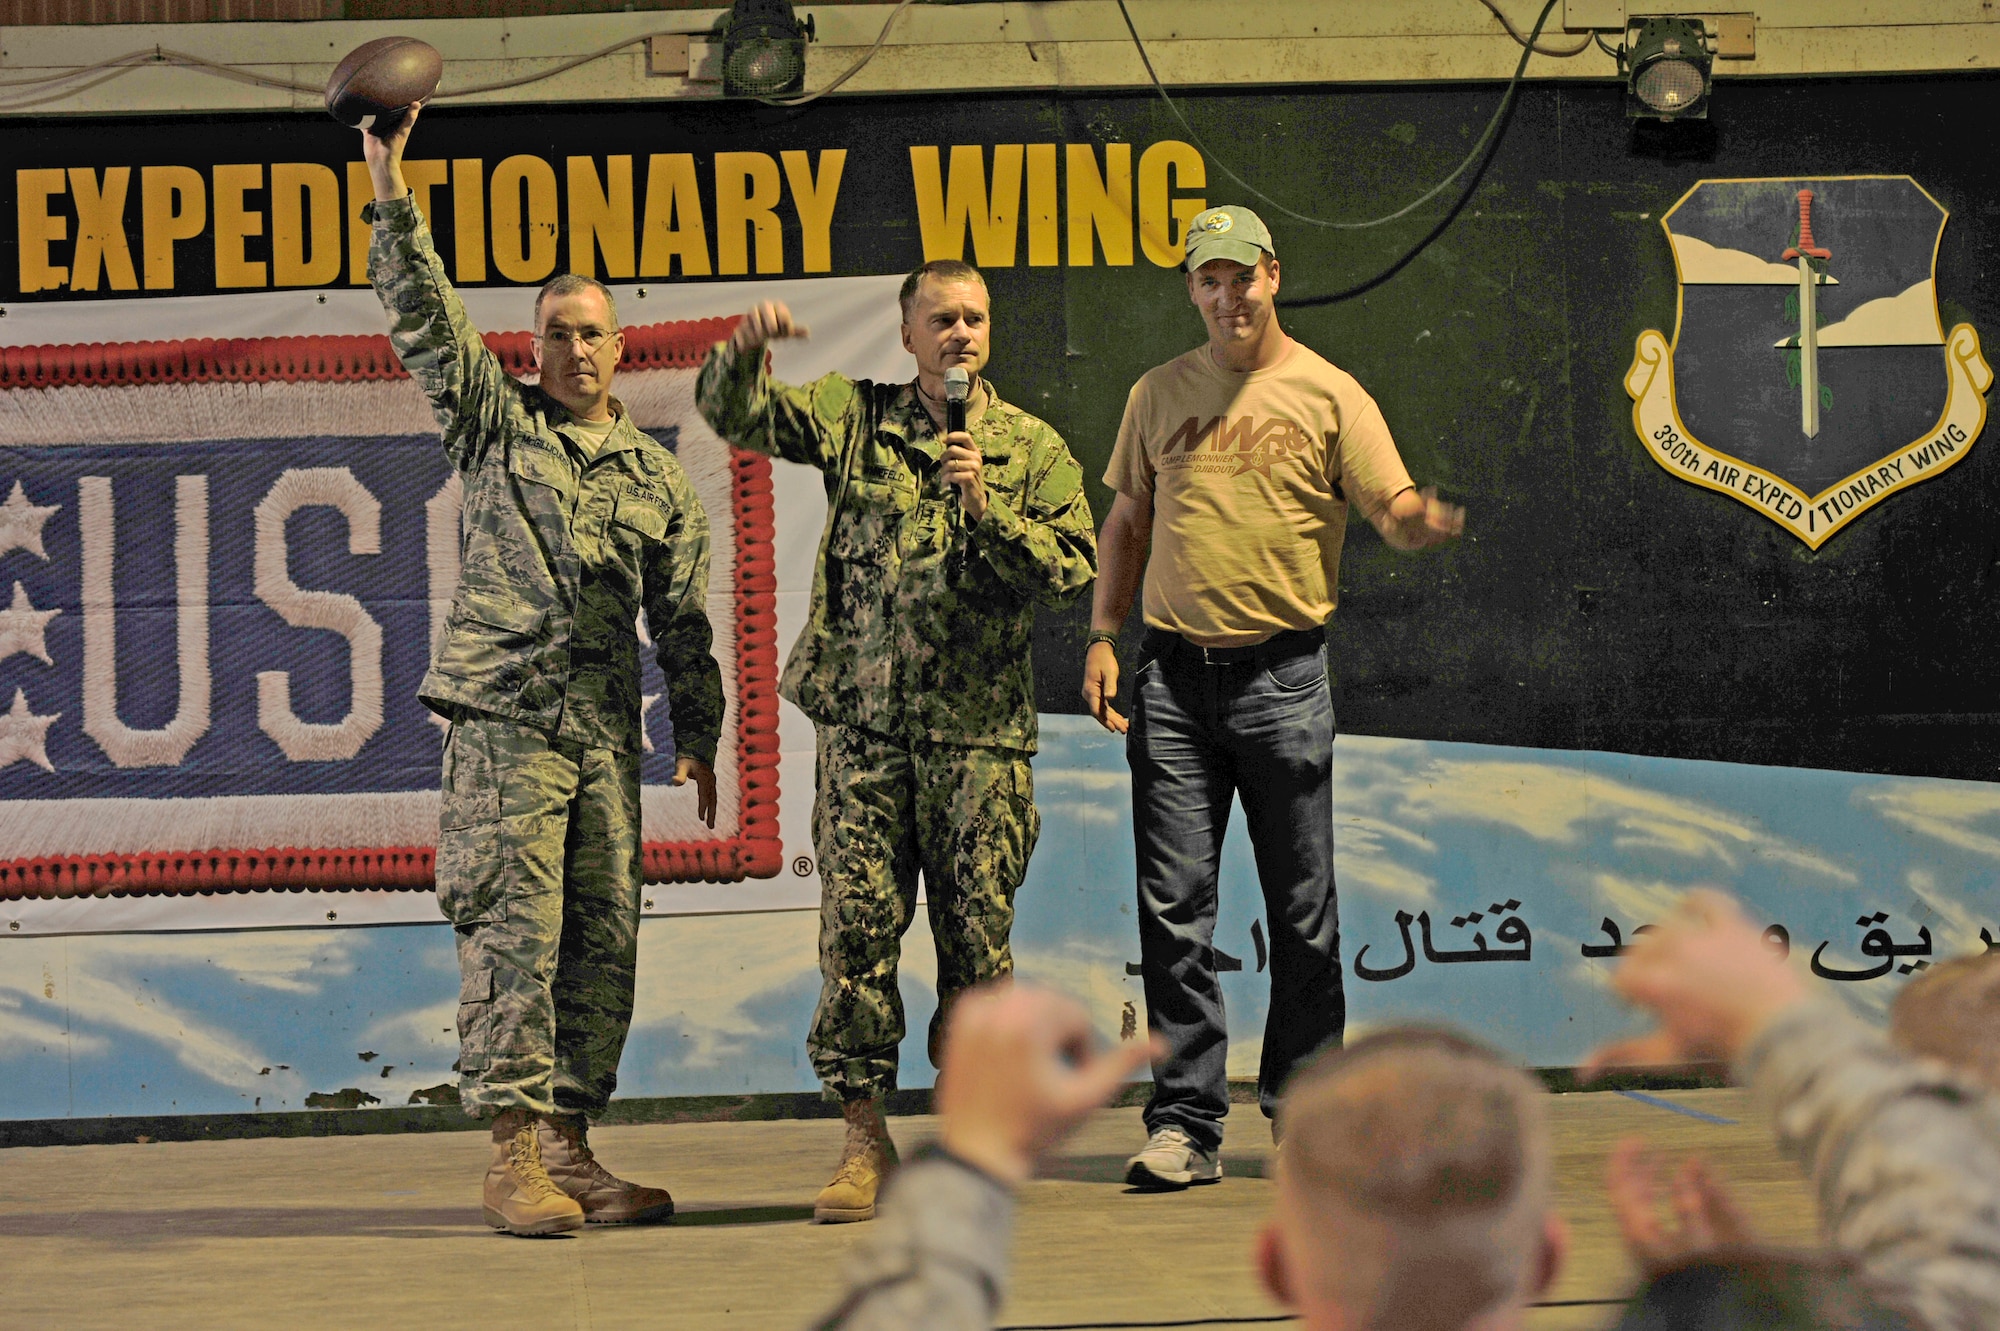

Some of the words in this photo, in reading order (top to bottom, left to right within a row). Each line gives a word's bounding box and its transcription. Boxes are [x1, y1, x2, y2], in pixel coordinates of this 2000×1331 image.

[910, 140, 1206, 268] WING
[1161, 416, 1302, 456] MWR
[1161, 454, 1182, 466] CAMP
[1181, 454, 1235, 463] LEMONNIER
[1653, 424, 1700, 472] 380th
[1703, 460, 1740, 487] AIR
[1908, 424, 1967, 470] WING
[626, 484, 640, 498] U.S.
[640, 491, 655, 503] AIR
[1193, 464, 1237, 474] DJIBOUTI
[79, 466, 463, 768] US
[1354, 898, 1531, 982] قتال
